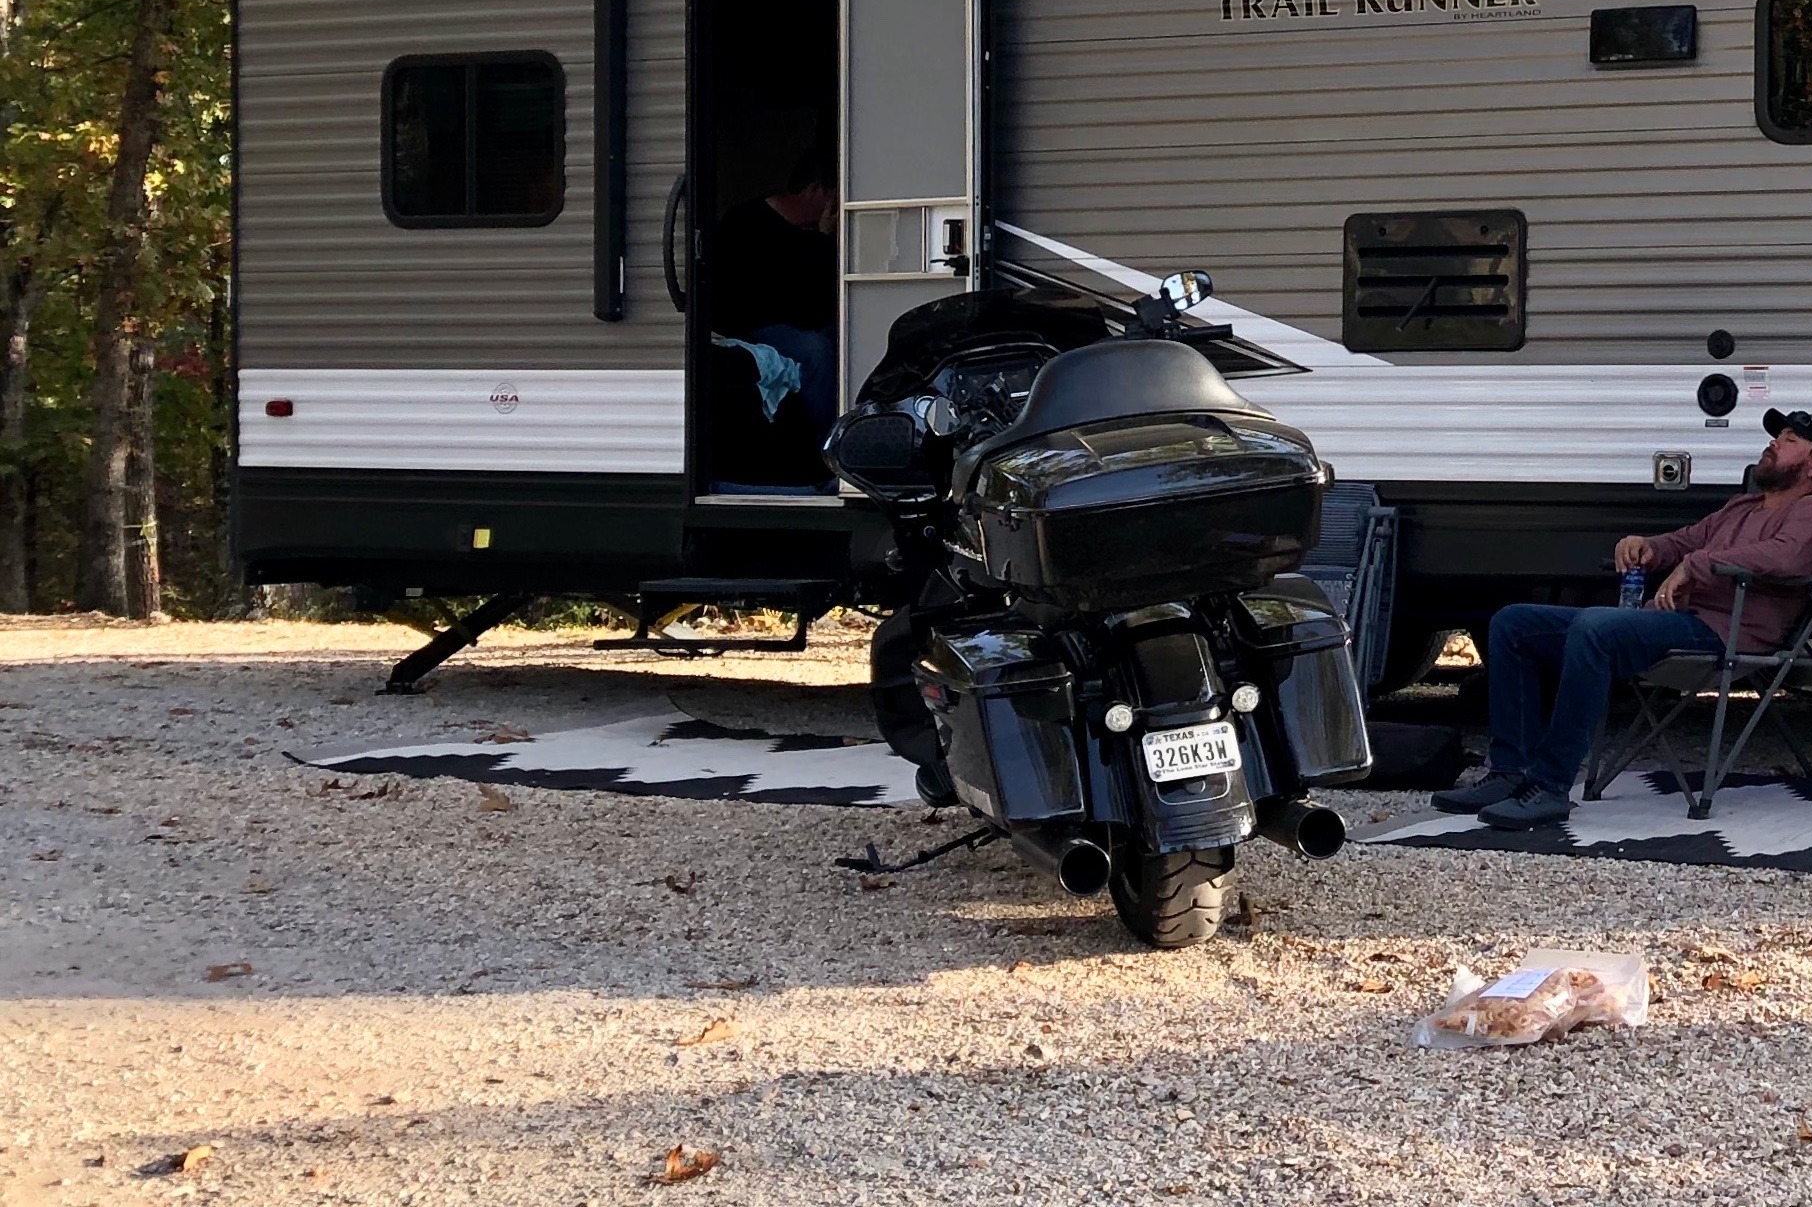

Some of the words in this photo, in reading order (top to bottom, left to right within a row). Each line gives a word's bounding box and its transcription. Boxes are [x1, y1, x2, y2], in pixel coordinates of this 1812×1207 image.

[1470, 9, 1542, 19] HEARTLAND
[489, 394, 519, 402] USA
[1163, 730, 1195, 743] TEXAS
[1153, 739, 1228, 769] 326K3W
